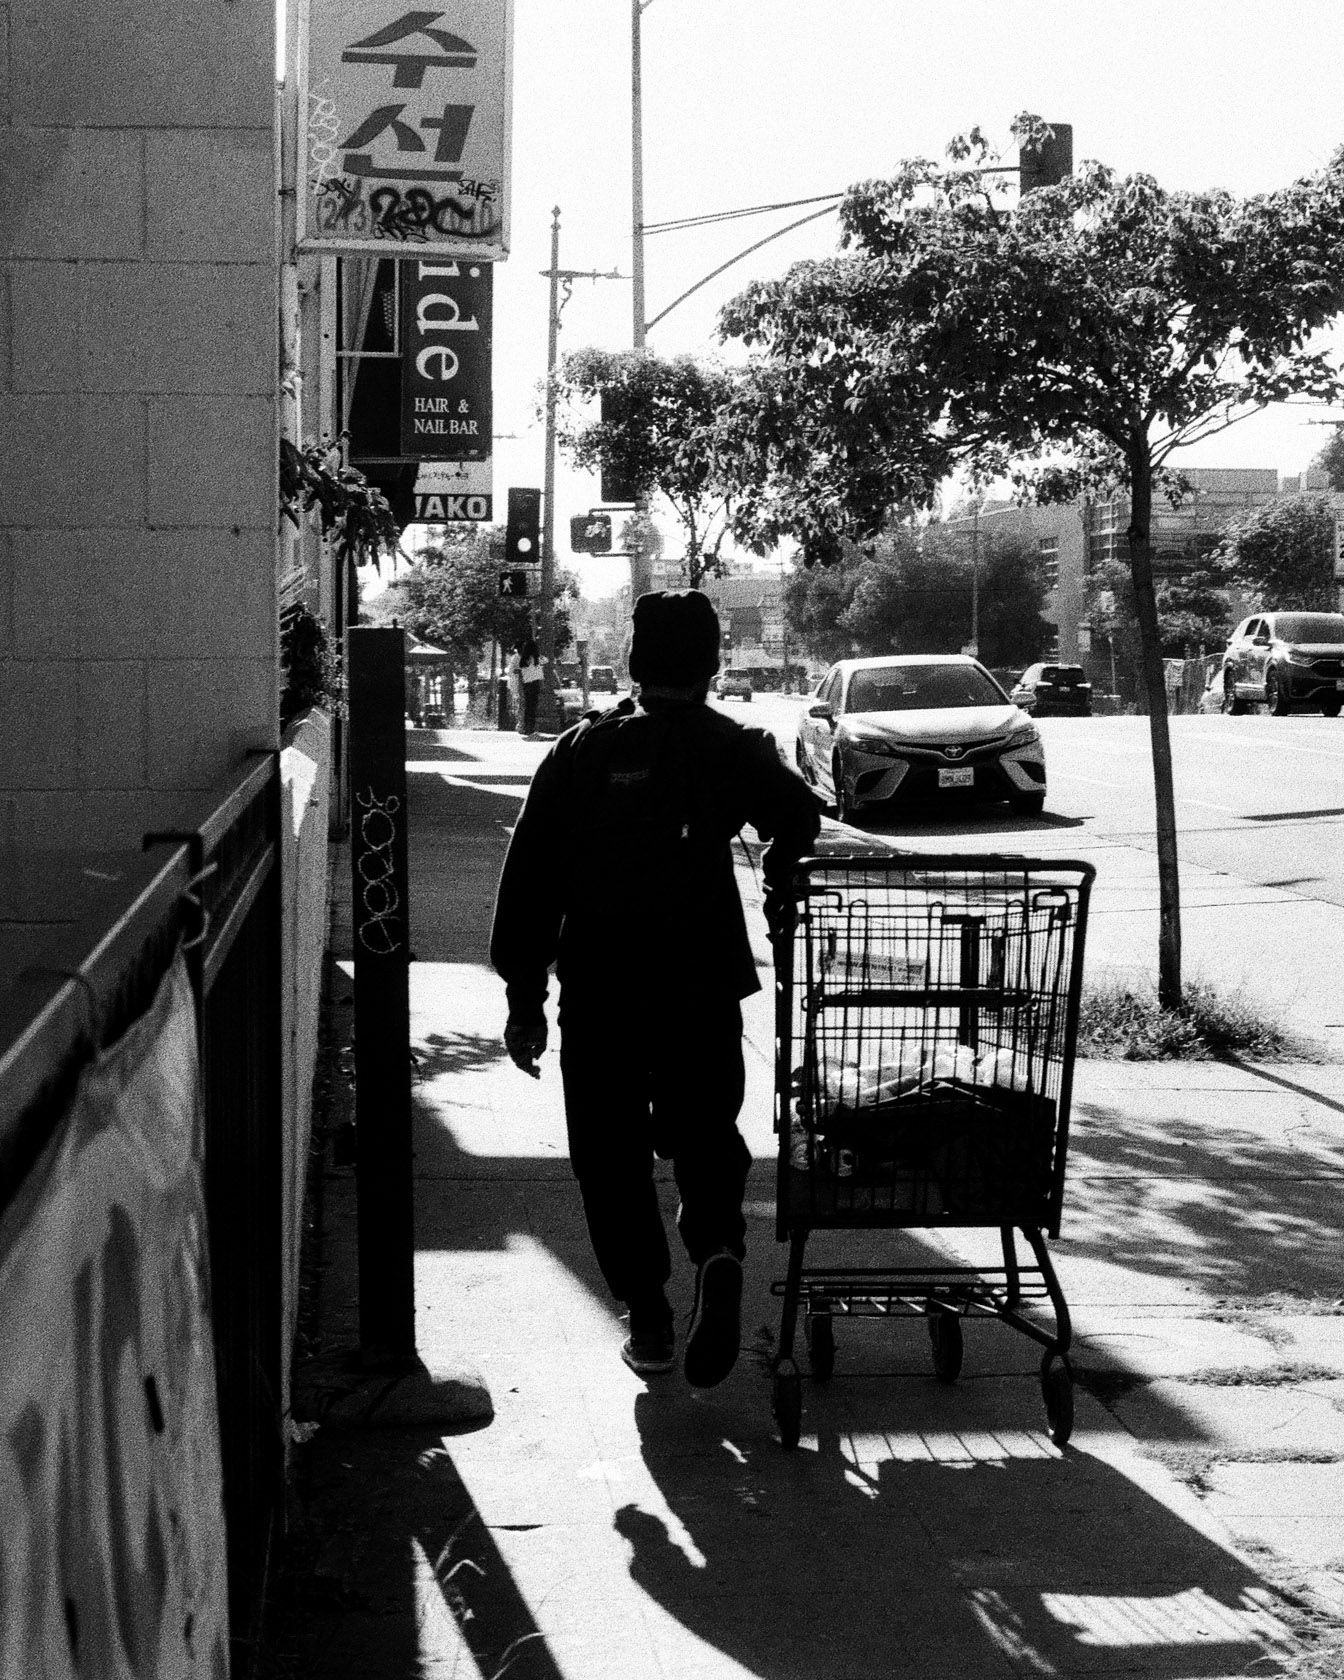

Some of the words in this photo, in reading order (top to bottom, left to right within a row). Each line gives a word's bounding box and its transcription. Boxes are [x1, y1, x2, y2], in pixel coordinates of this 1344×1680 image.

[337, 11, 478, 182] 수선
[416, 261, 480, 381] ide
[414, 398, 449, 413] HAIR
[457, 399, 469, 413] &
[414, 419, 448, 434] NAIL
[450, 420, 479, 435] BAR
